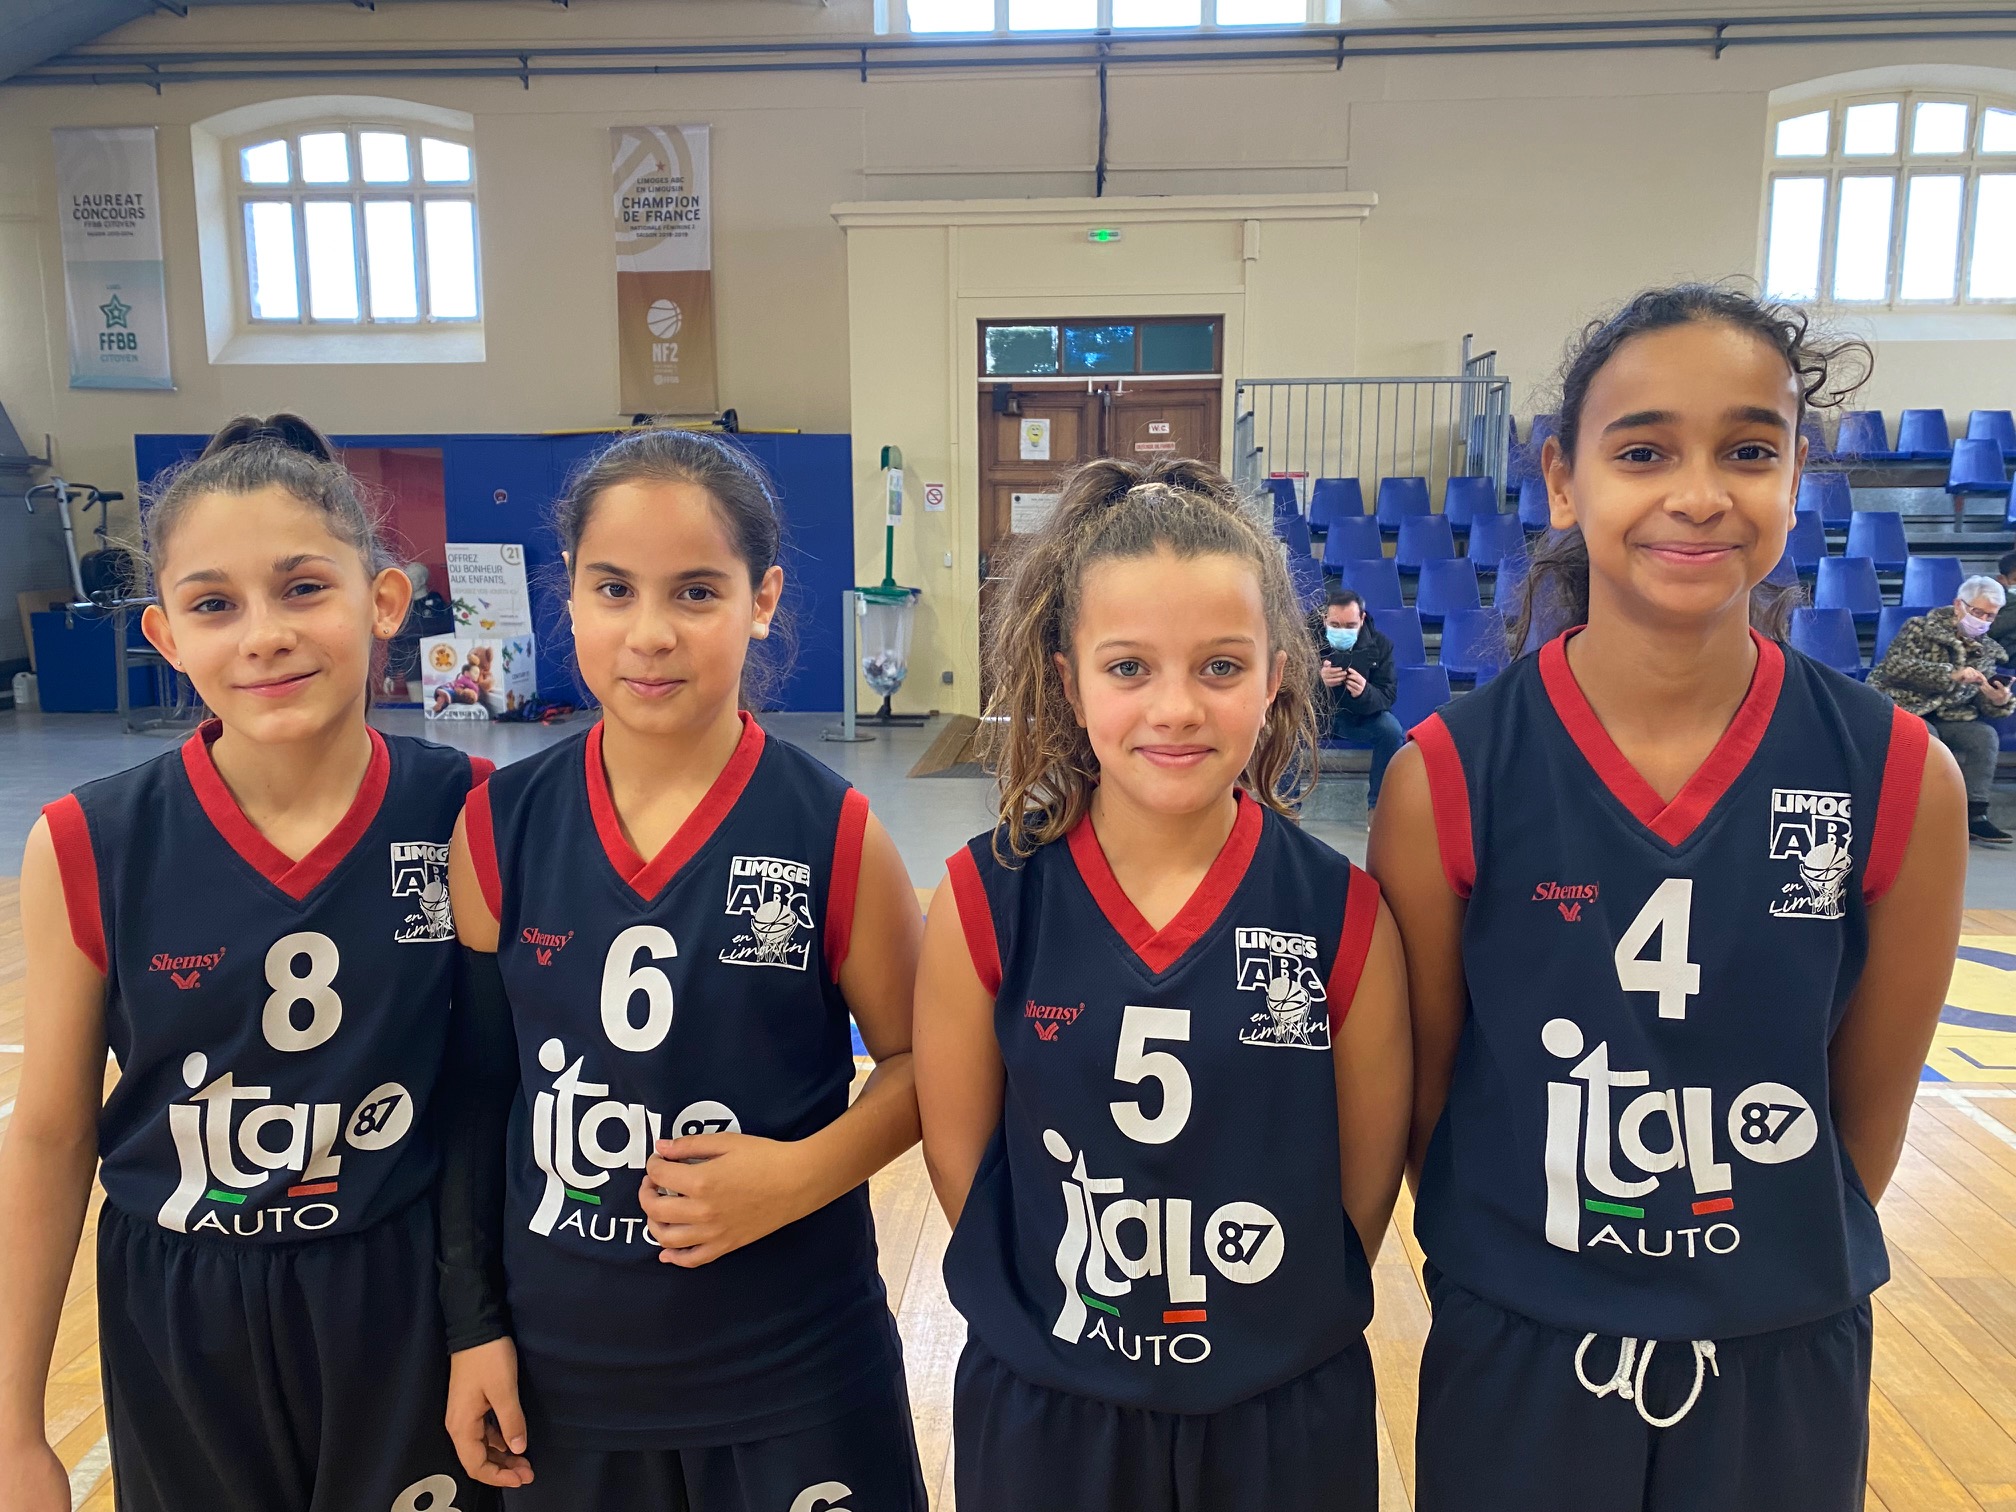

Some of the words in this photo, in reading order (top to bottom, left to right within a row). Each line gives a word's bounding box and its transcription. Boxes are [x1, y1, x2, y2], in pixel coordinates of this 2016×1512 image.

[73, 193, 143, 207] LAUREAT
[622, 196, 699, 209] CHAMPION
[73, 207, 146, 220] CONCOURS
[623, 211, 640, 222] DE
[646, 209, 701, 222] FRANCE
[99, 332, 137, 351] FFBB
[652, 342, 679, 362] NF2
[448, 553, 478, 563] OFFREZ
[506, 547, 520, 559] 21
[449, 565, 462, 573] DU
[463, 564, 503, 574] BONHEUR
[451, 575, 466, 583] AUX
[1781, 882, 1803, 894] en
[404, 914, 423, 923] en
[732, 934, 753, 943] en
[1614, 878, 1700, 1020] 4
[148, 952, 226, 971] Shemsy
[262, 931, 343, 1052] 8
[600, 925, 678, 1052] 6
[1250, 1012, 1270, 1023] en
[1109, 1005, 1192, 1144] 5
[353, 1093, 404, 1136] 87
[1740, 1102, 1806, 1145] 87
[192, 1203, 339, 1236] AUTO
[1216, 1220, 1275, 1265] 87
[1587, 1223, 1740, 1258] AUTO
[1087, 1316, 1212, 1366] AUTO
